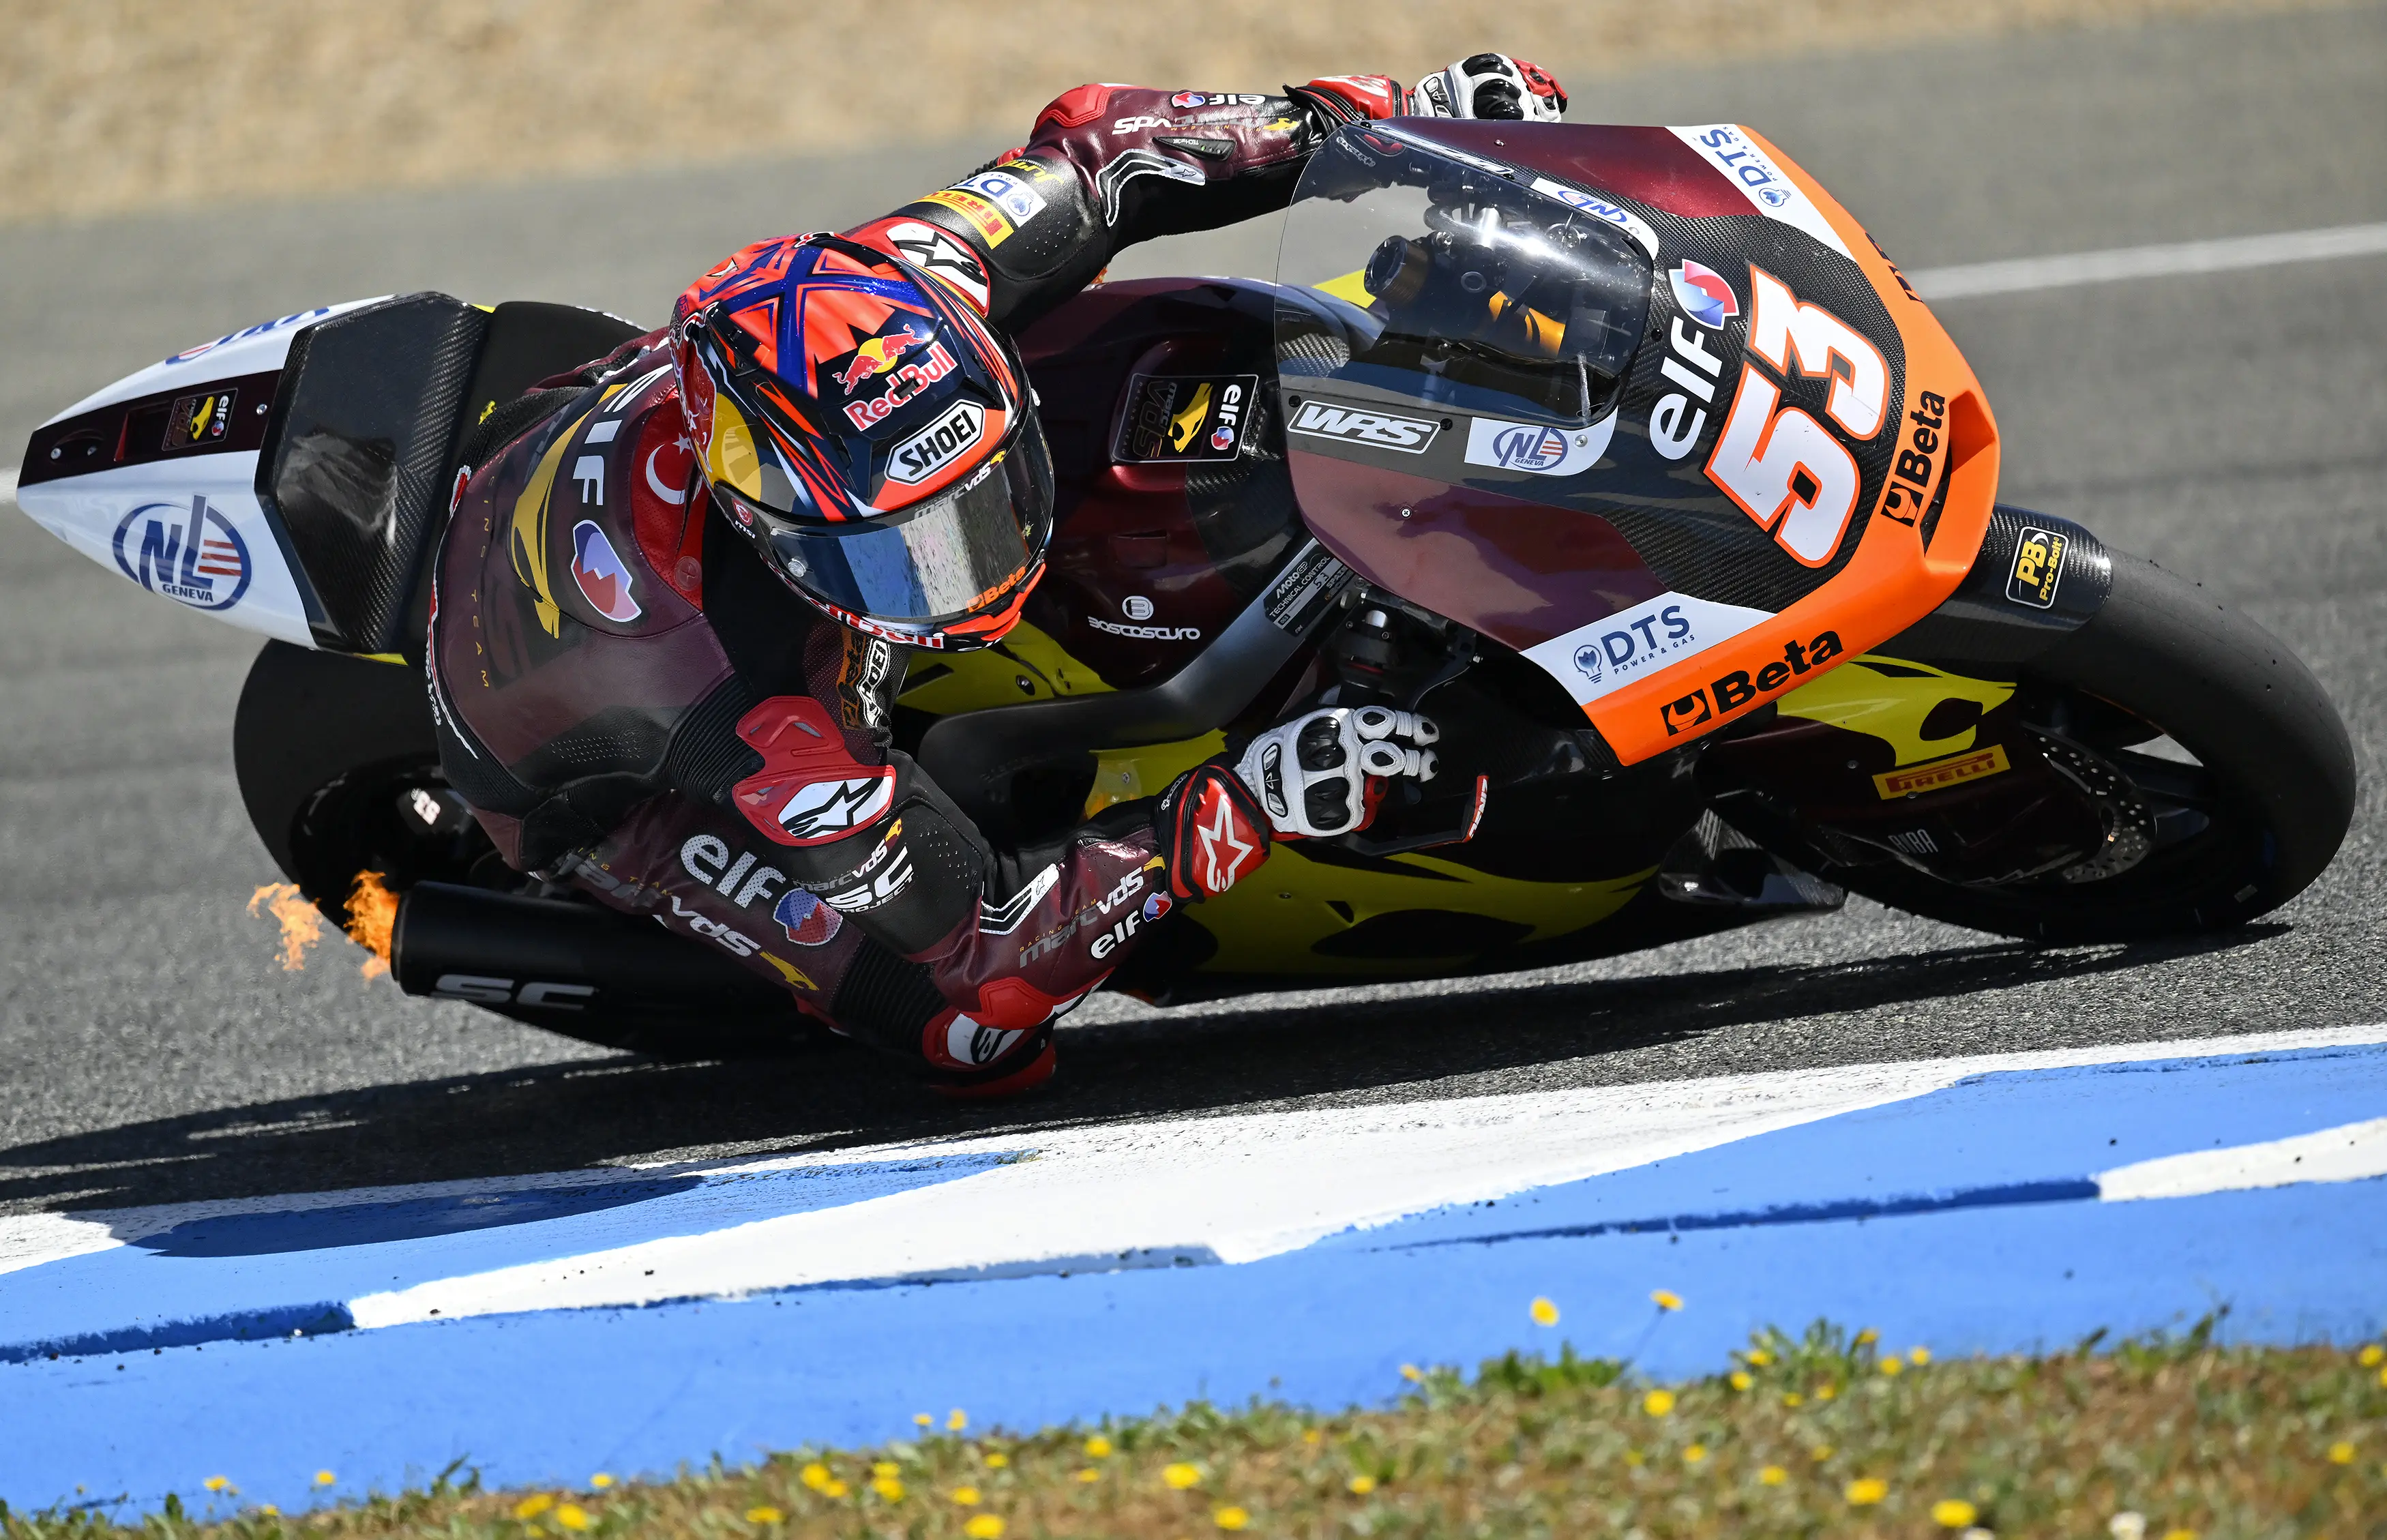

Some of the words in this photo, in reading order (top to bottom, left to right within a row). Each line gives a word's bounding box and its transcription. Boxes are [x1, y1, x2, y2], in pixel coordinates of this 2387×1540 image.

[1700, 130, 1772, 187] DTS
[900, 344, 956, 394] Bull
[1649, 316, 1723, 460] elf
[1219, 384, 1241, 426] elf
[1296, 404, 1434, 445] WRS
[1704, 266, 1891, 568] 53
[898, 409, 976, 475] SHOEI
[1897, 390, 1946, 490] Beta
[985, 567, 1026, 600] Beta
[1269, 584, 1303, 617] TECHNICAL
[1302, 557, 1331, 585] CONTROL
[2015, 541, 2047, 587] PB
[162, 583, 213, 603] GENEVA
[1601, 606, 1690, 667] DTS
[1614, 653, 1655, 675] POWER
[1673, 634, 1695, 648] GAS
[1713, 630, 1843, 712] Beta
[681, 834, 786, 908] elf
[826, 846, 913, 908] SC
[1020, 925, 1062, 953] RACING
[1091, 910, 1140, 959] elf
[430, 974, 600, 1010] SC
